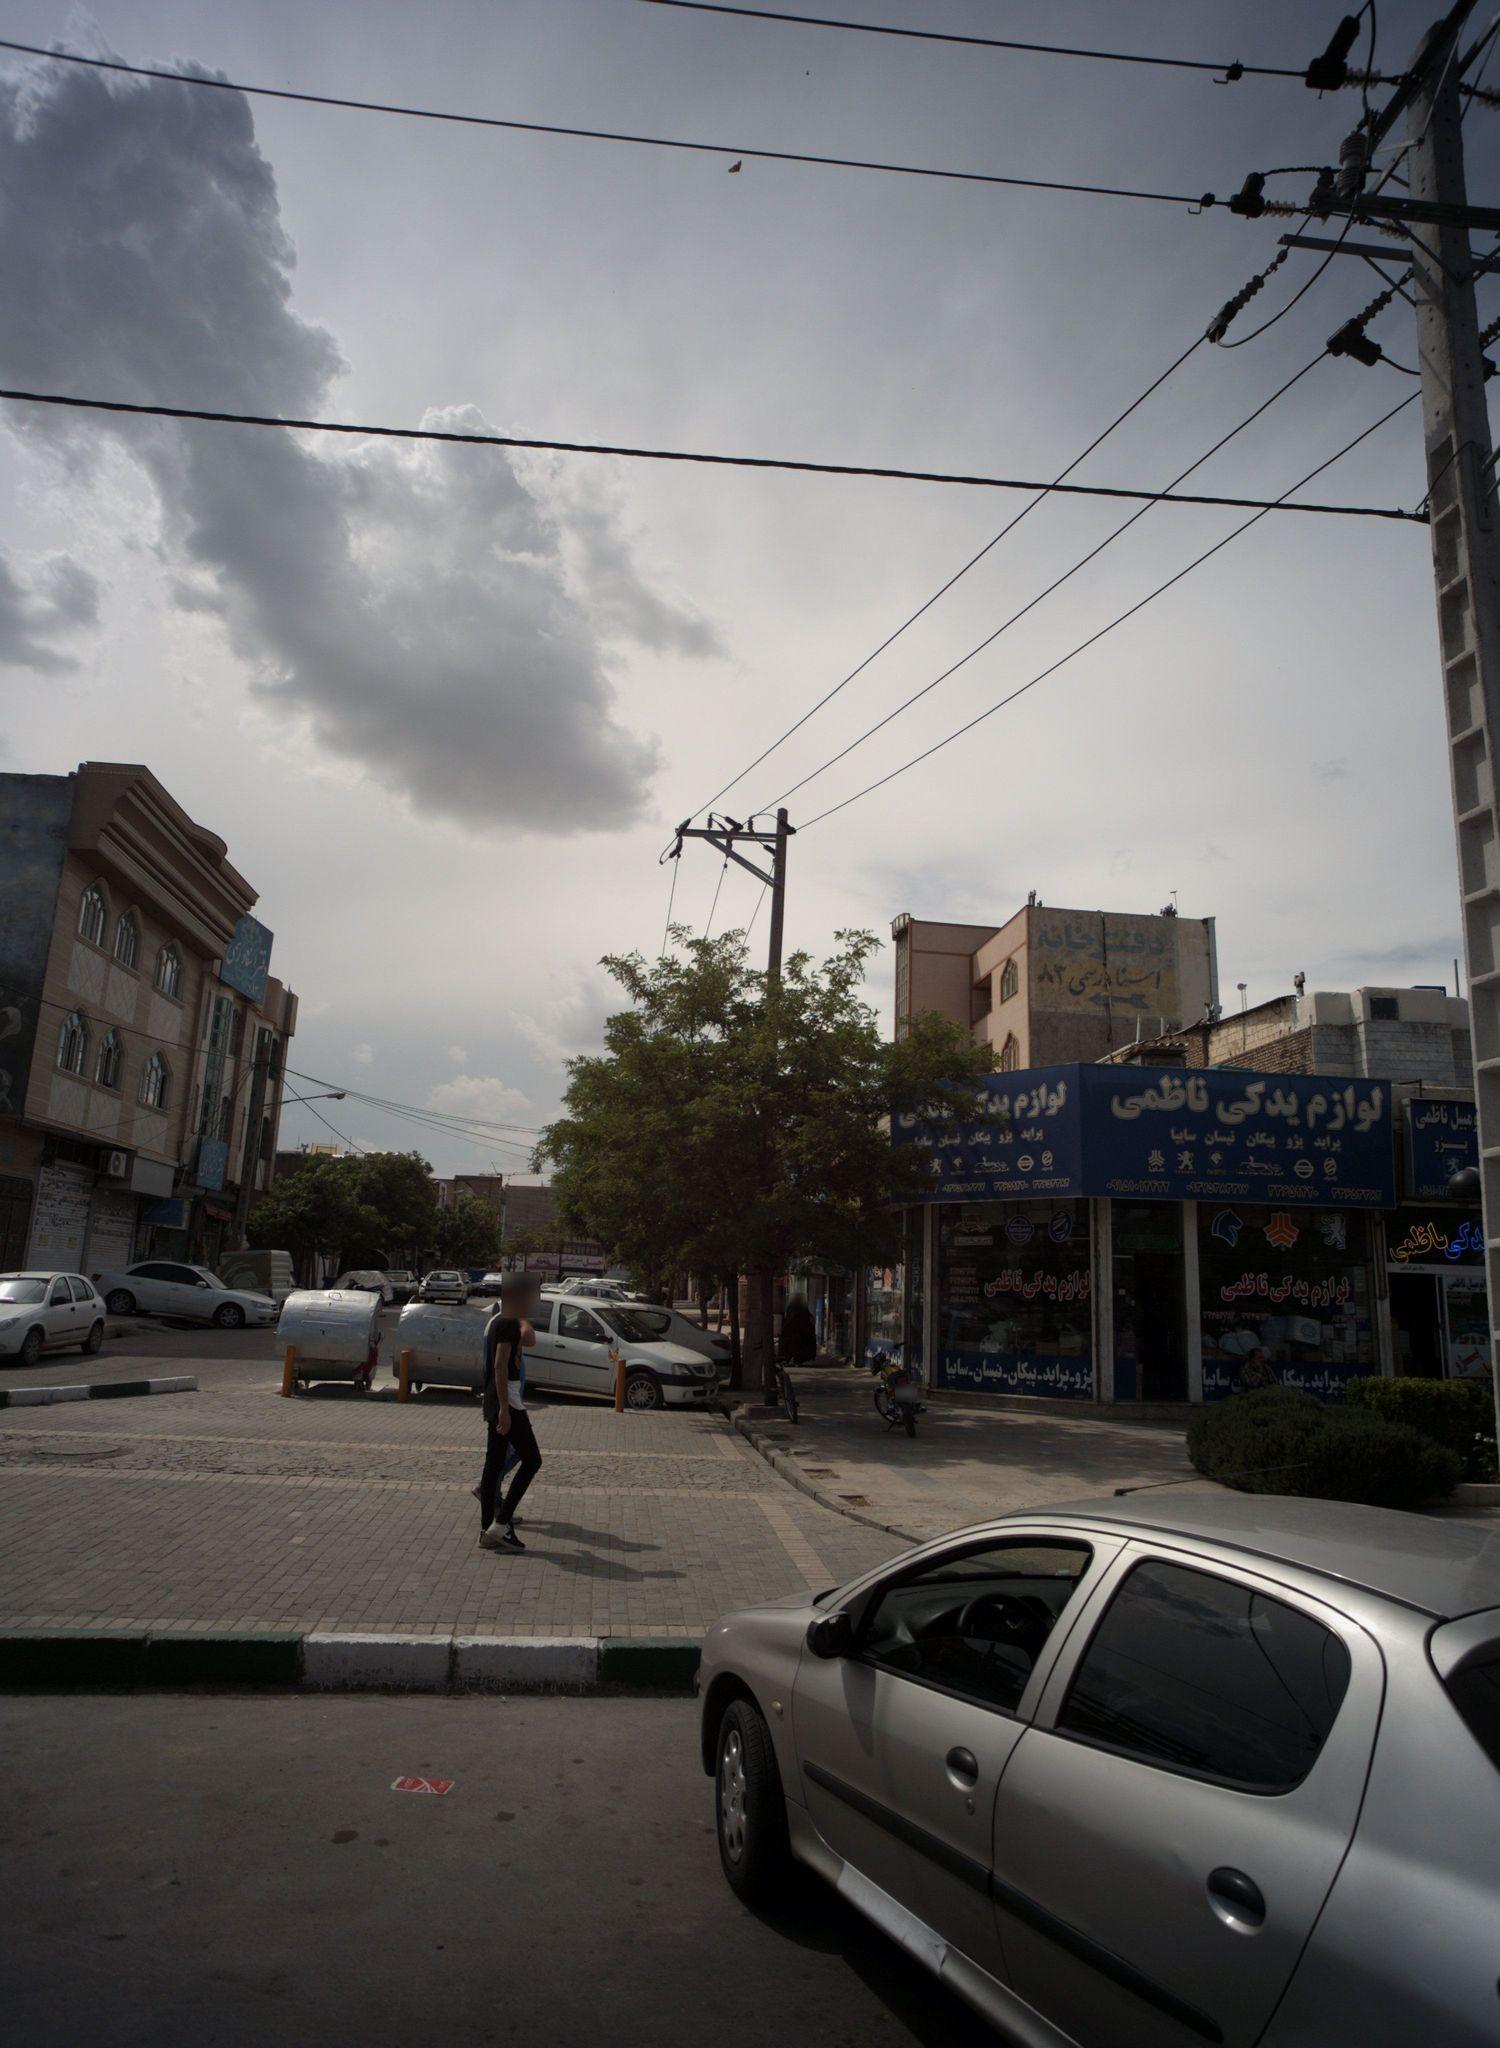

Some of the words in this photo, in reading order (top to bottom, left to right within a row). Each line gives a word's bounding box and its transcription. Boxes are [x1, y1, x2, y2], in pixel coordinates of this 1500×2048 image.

[1012, 1080, 1068, 1120] لوازم
[1109, 1074, 1209, 1121] ناظمی
[1215, 1080, 1299, 1127] یدکی
[1305, 1083, 1384, 1132] لوازم
[1415, 1103, 1449, 1130] ناظمی
[967, 1130, 992, 1146] پیکان
[1170, 1127, 1197, 1145] سایپا
[1204, 1129, 1237, 1147] نیسان
[1246, 1131, 1276, 1149] پیکان
[1285, 1133, 1305, 1151] پژو
[1313, 1134, 1342, 1152] پراید
[1388, 1221, 1449, 1264] ناظمی
[984, 1269, 1022, 1298] ناظمی
[1022, 1270, 1057, 1301] یدکی
[1059, 1269, 1091, 1302] لوازم
[1220, 1271, 1269, 1302] ناظمی
[1269, 1273, 1309, 1306] یدکی
[1310, 1275, 1350, 1308] لوازم
